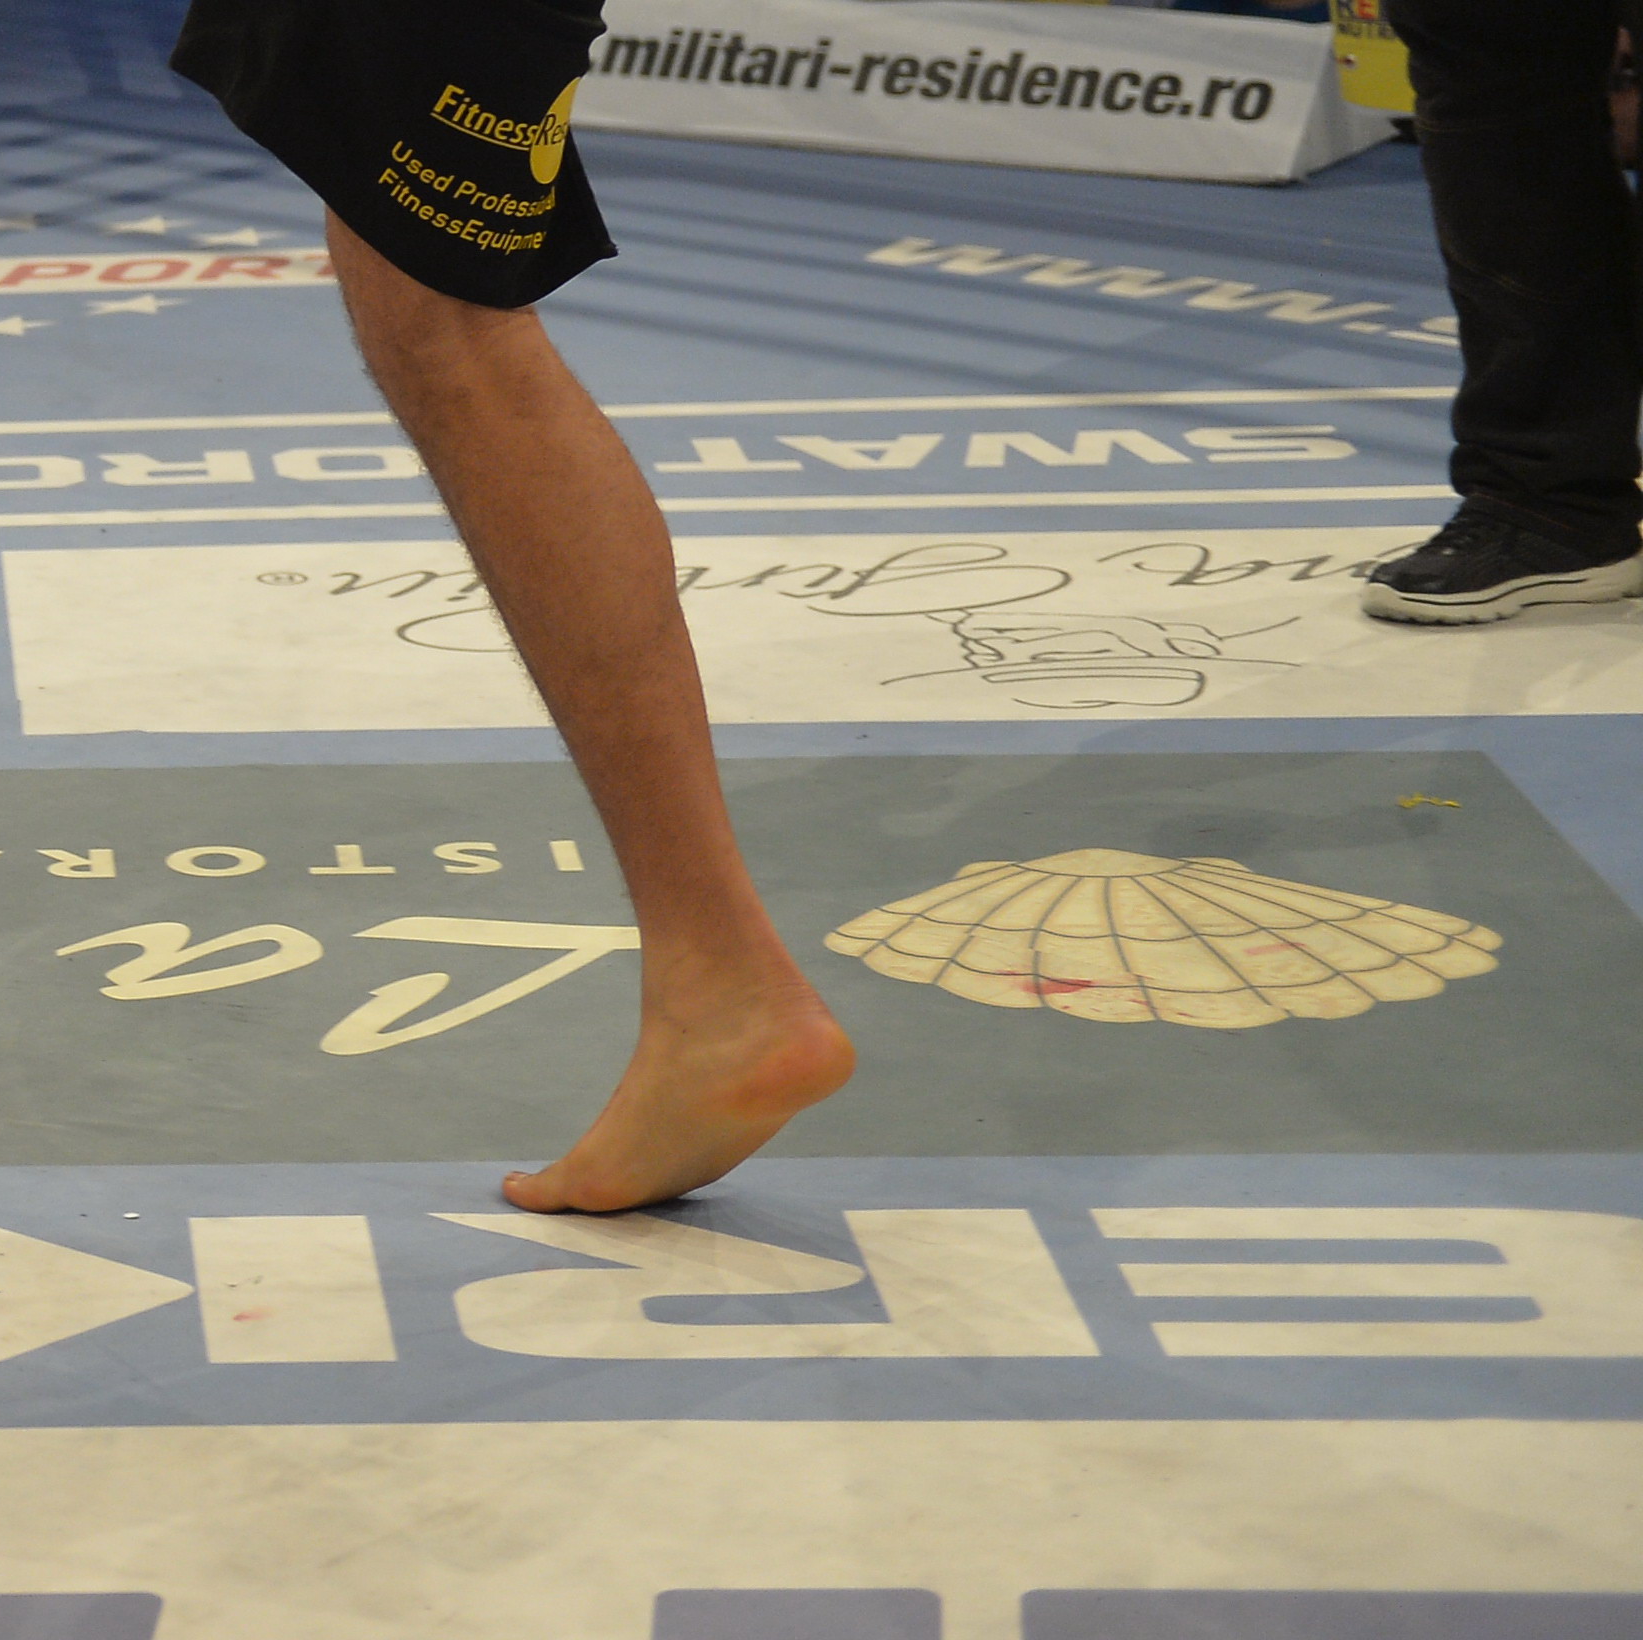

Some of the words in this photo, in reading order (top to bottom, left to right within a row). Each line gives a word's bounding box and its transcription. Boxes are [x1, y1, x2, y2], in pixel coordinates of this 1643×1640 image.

[431, 84, 541, 150] Fitness
[391, 139, 451, 195] Used
[658, 424, 1361, 475] SWAT
